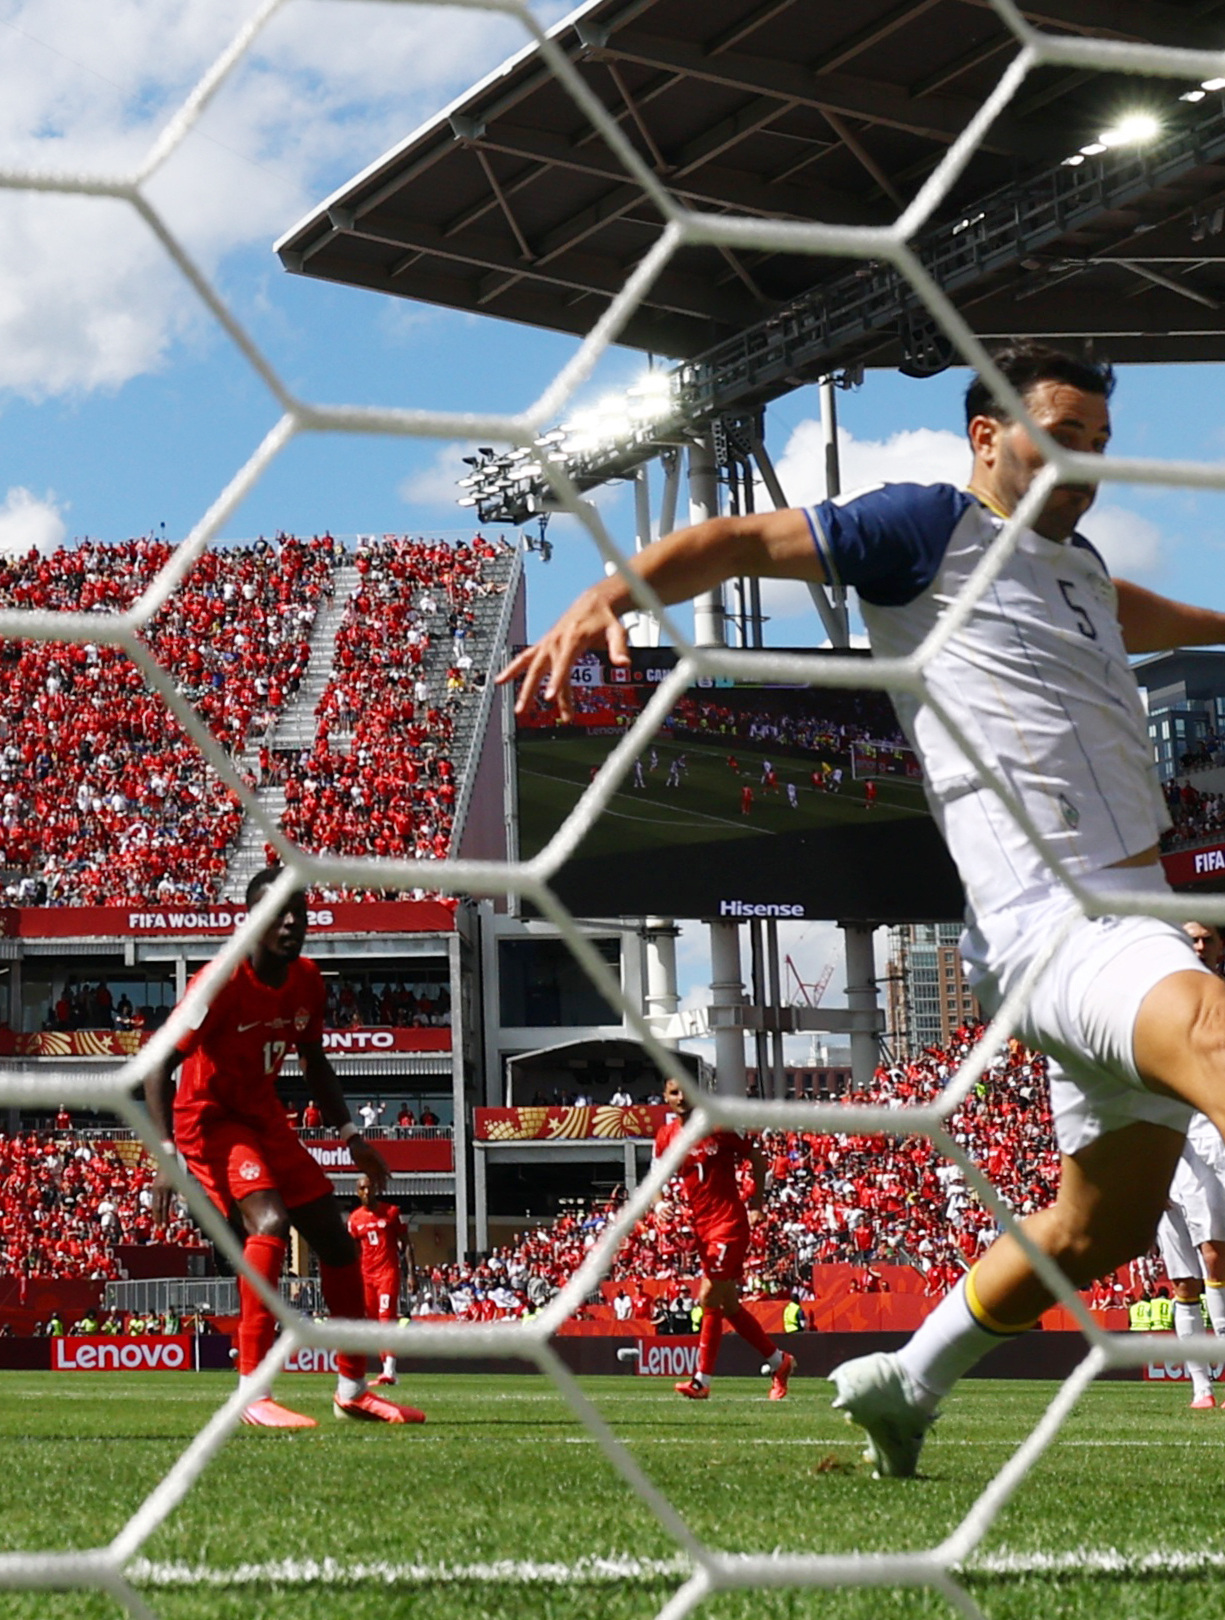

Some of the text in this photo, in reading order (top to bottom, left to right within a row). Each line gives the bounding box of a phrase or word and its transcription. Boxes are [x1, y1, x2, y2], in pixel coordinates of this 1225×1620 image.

[1056, 579, 1097, 639] 5
[1195, 850, 1225, 873] FIFA
[129, 913, 166, 928] FIFA
[169, 913, 231, 928] WORLD
[721, 900, 804, 916] Hisense
[57, 1339, 184, 1369] Lenovo
[638, 1339, 701, 1375] Lenov
